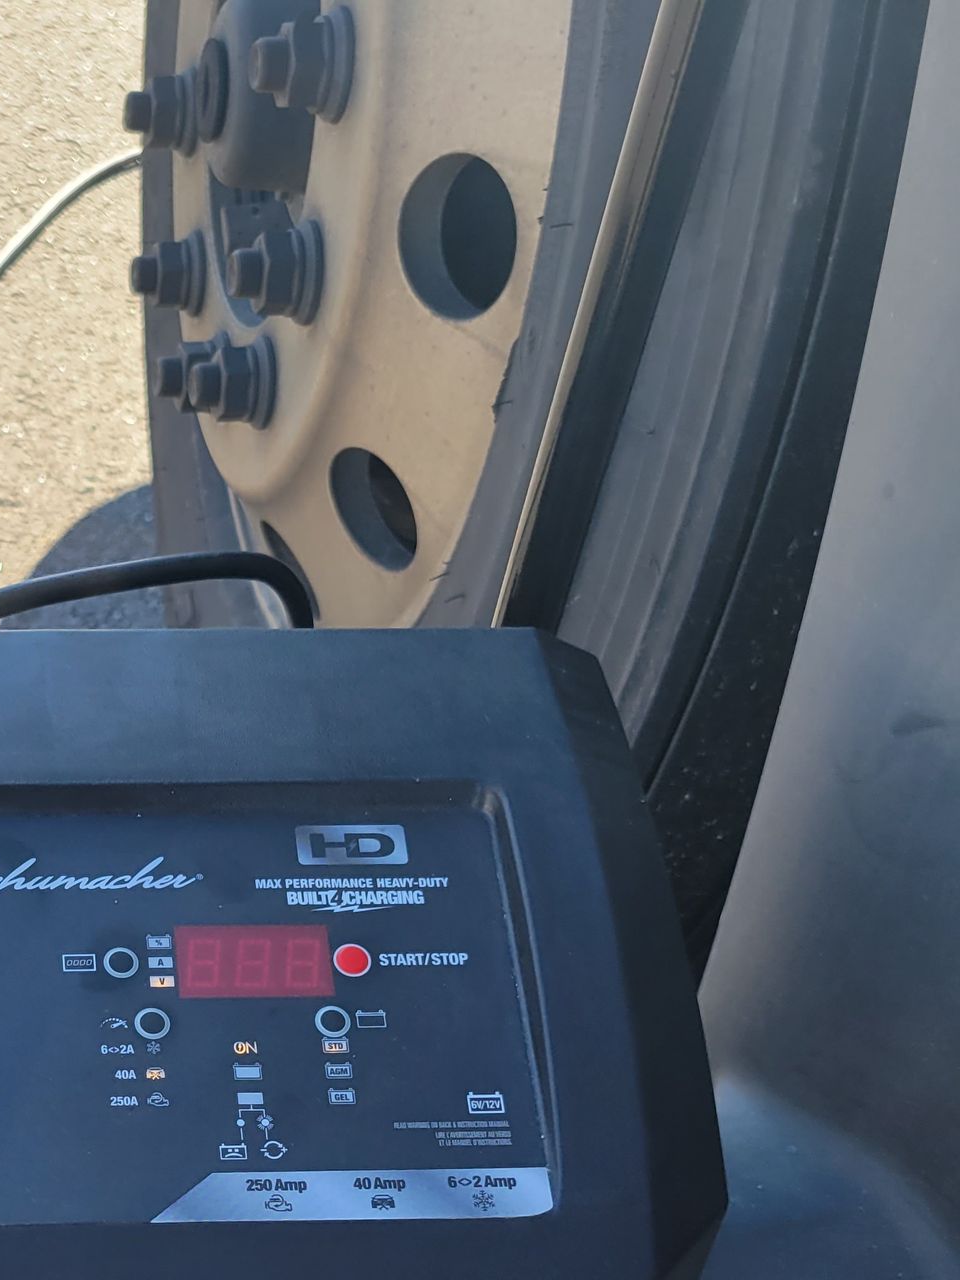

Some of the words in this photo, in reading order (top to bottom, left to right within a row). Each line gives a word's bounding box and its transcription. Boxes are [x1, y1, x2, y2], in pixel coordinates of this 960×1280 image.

[309, 831, 397, 859] HD
[255, 878, 282, 890] MAX
[284, 878, 374, 889] PERFORMANCE
[376, 877, 449, 889] HEAVY-DUTY
[157, 958, 165, 967] A
[378, 953, 469, 967] START/STOP
[158, 977, 166, 986] V
[233, 1041, 258, 1056] ON
[114, 1068, 137, 1081] 40A
[329, 1066, 349, 1076] AGM
[110, 1095, 139, 1108] 250A
[333, 1092, 352, 1102] GEL
[471, 1099, 501, 1110] 6V/12V
[246, 1178, 272, 1192] 250
[275, 1178, 308, 1194] Amp
[353, 1176, 371, 1190] 40
[373, 1176, 407, 1193] Amp
[483, 1174, 517, 1191] Amp
